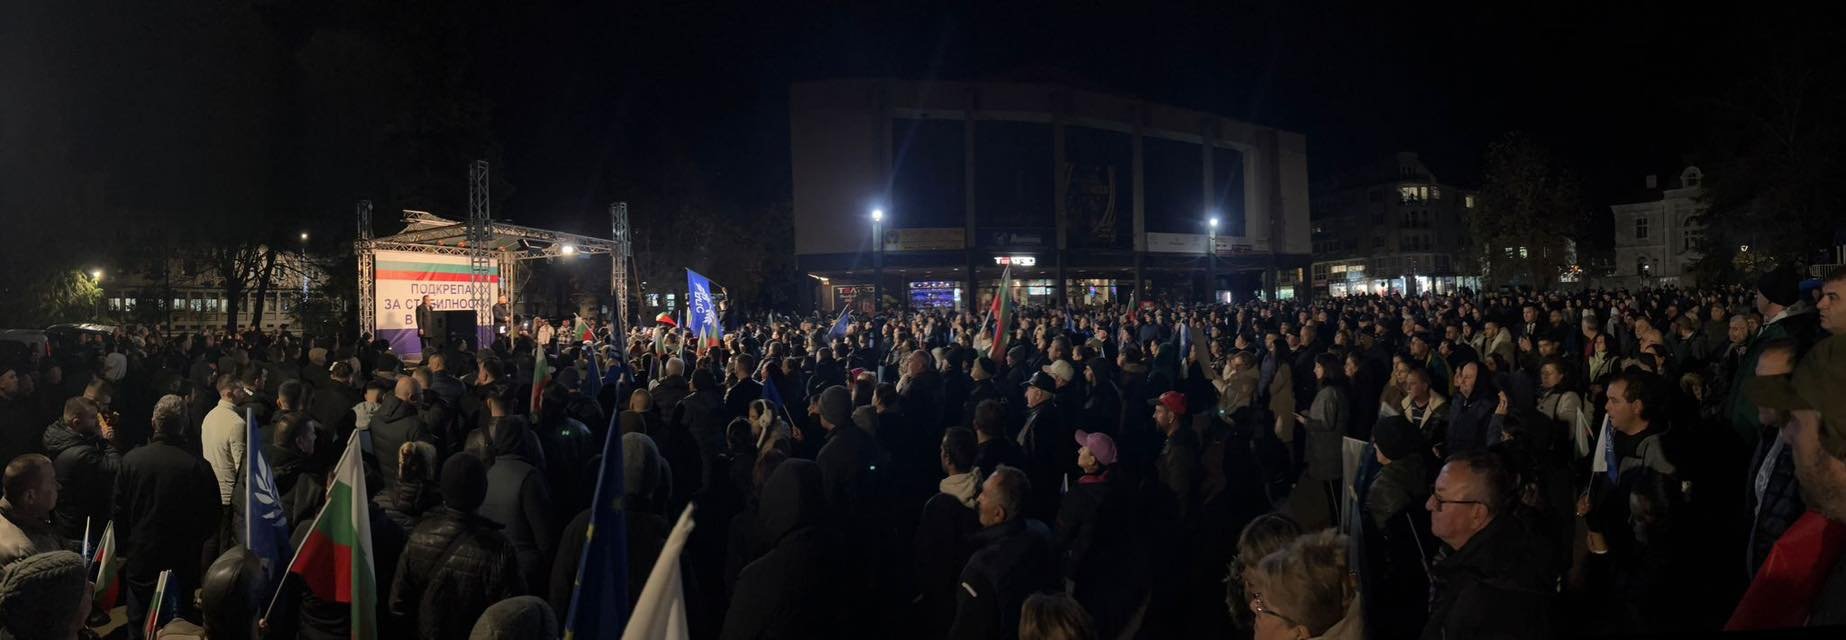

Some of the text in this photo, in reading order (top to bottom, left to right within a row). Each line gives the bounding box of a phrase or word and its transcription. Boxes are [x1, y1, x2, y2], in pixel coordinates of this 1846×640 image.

[411, 283, 472, 295] ПОДКРЕПА
[384, 298, 401, 310] ЗА
[405, 314, 413, 325] В
